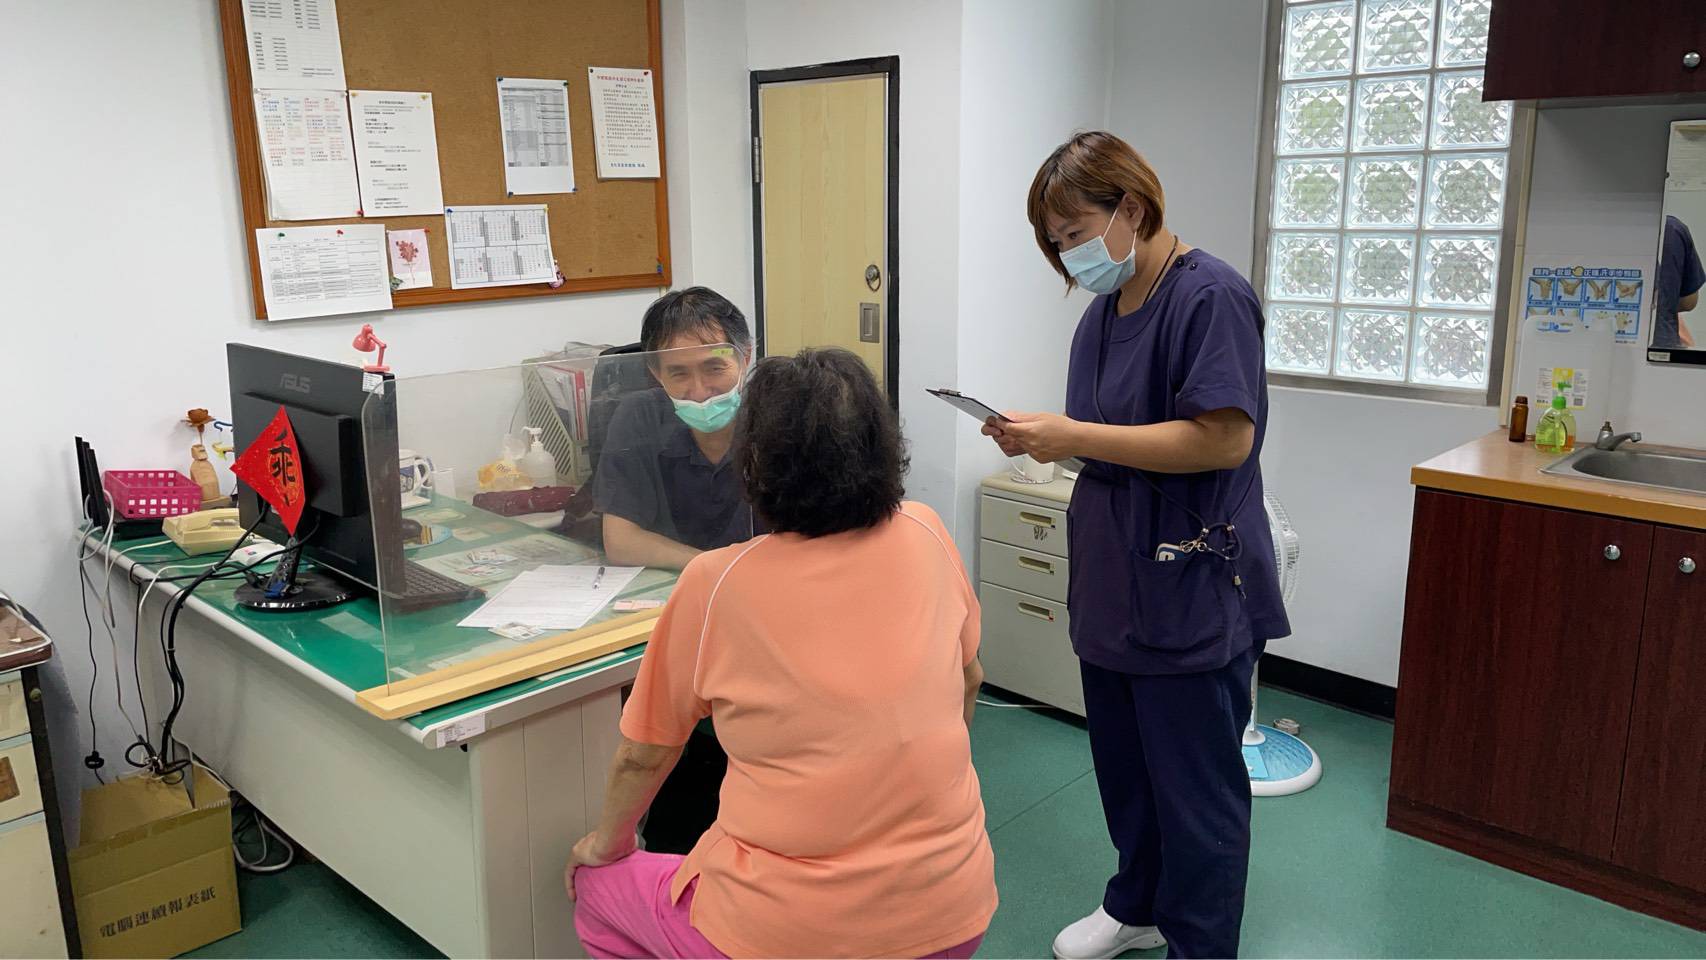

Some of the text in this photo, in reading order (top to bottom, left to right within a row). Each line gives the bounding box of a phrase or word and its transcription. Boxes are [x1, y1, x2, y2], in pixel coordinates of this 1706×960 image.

[280, 373, 311, 393] ASUS
[99, 886, 216, 938] 電腦連續報表紙
